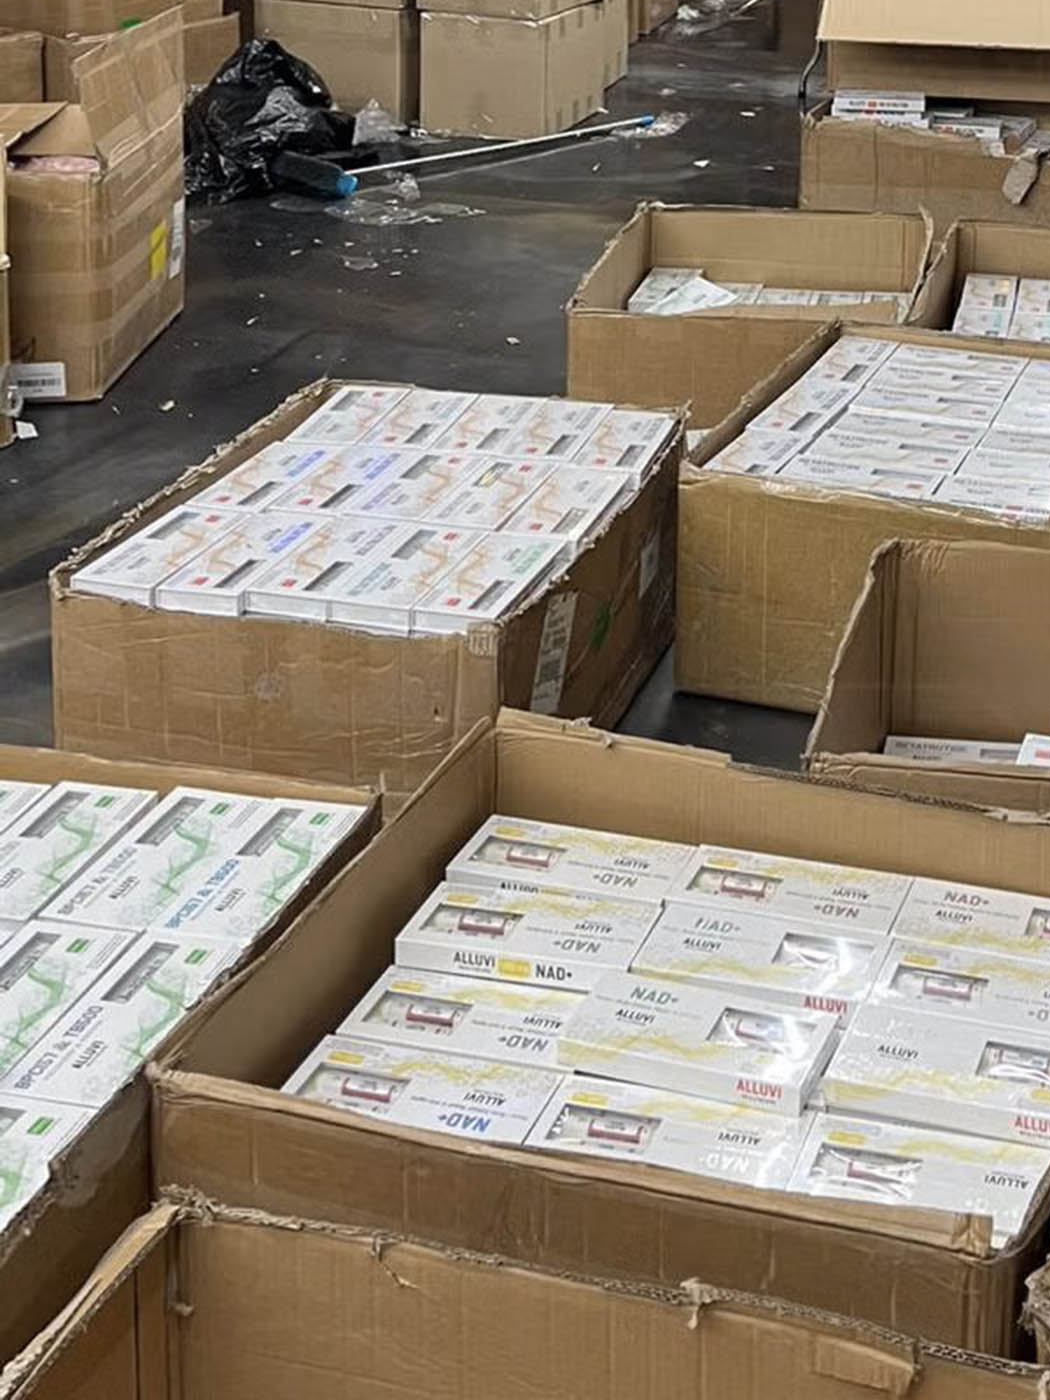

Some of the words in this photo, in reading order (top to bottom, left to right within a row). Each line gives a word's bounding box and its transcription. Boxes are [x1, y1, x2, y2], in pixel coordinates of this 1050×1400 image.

[453, 951, 496, 969] ALLUVI
[535, 963, 573, 982] NAD+
[803, 996, 848, 1015] ALLUVI
[615, 1008, 656, 1024] ALLUVI
[499, 1034, 549, 1053] NAD+
[877, 1044, 920, 1060] ALLUVI
[736, 1079, 782, 1100] ALLUVI
[464, 1091, 506, 1107] ALLUVI
[438, 1111, 492, 1134] NAD+
[718, 1131, 761, 1147] ALLUVI
[984, 1174, 1029, 1190] ALLUVI
